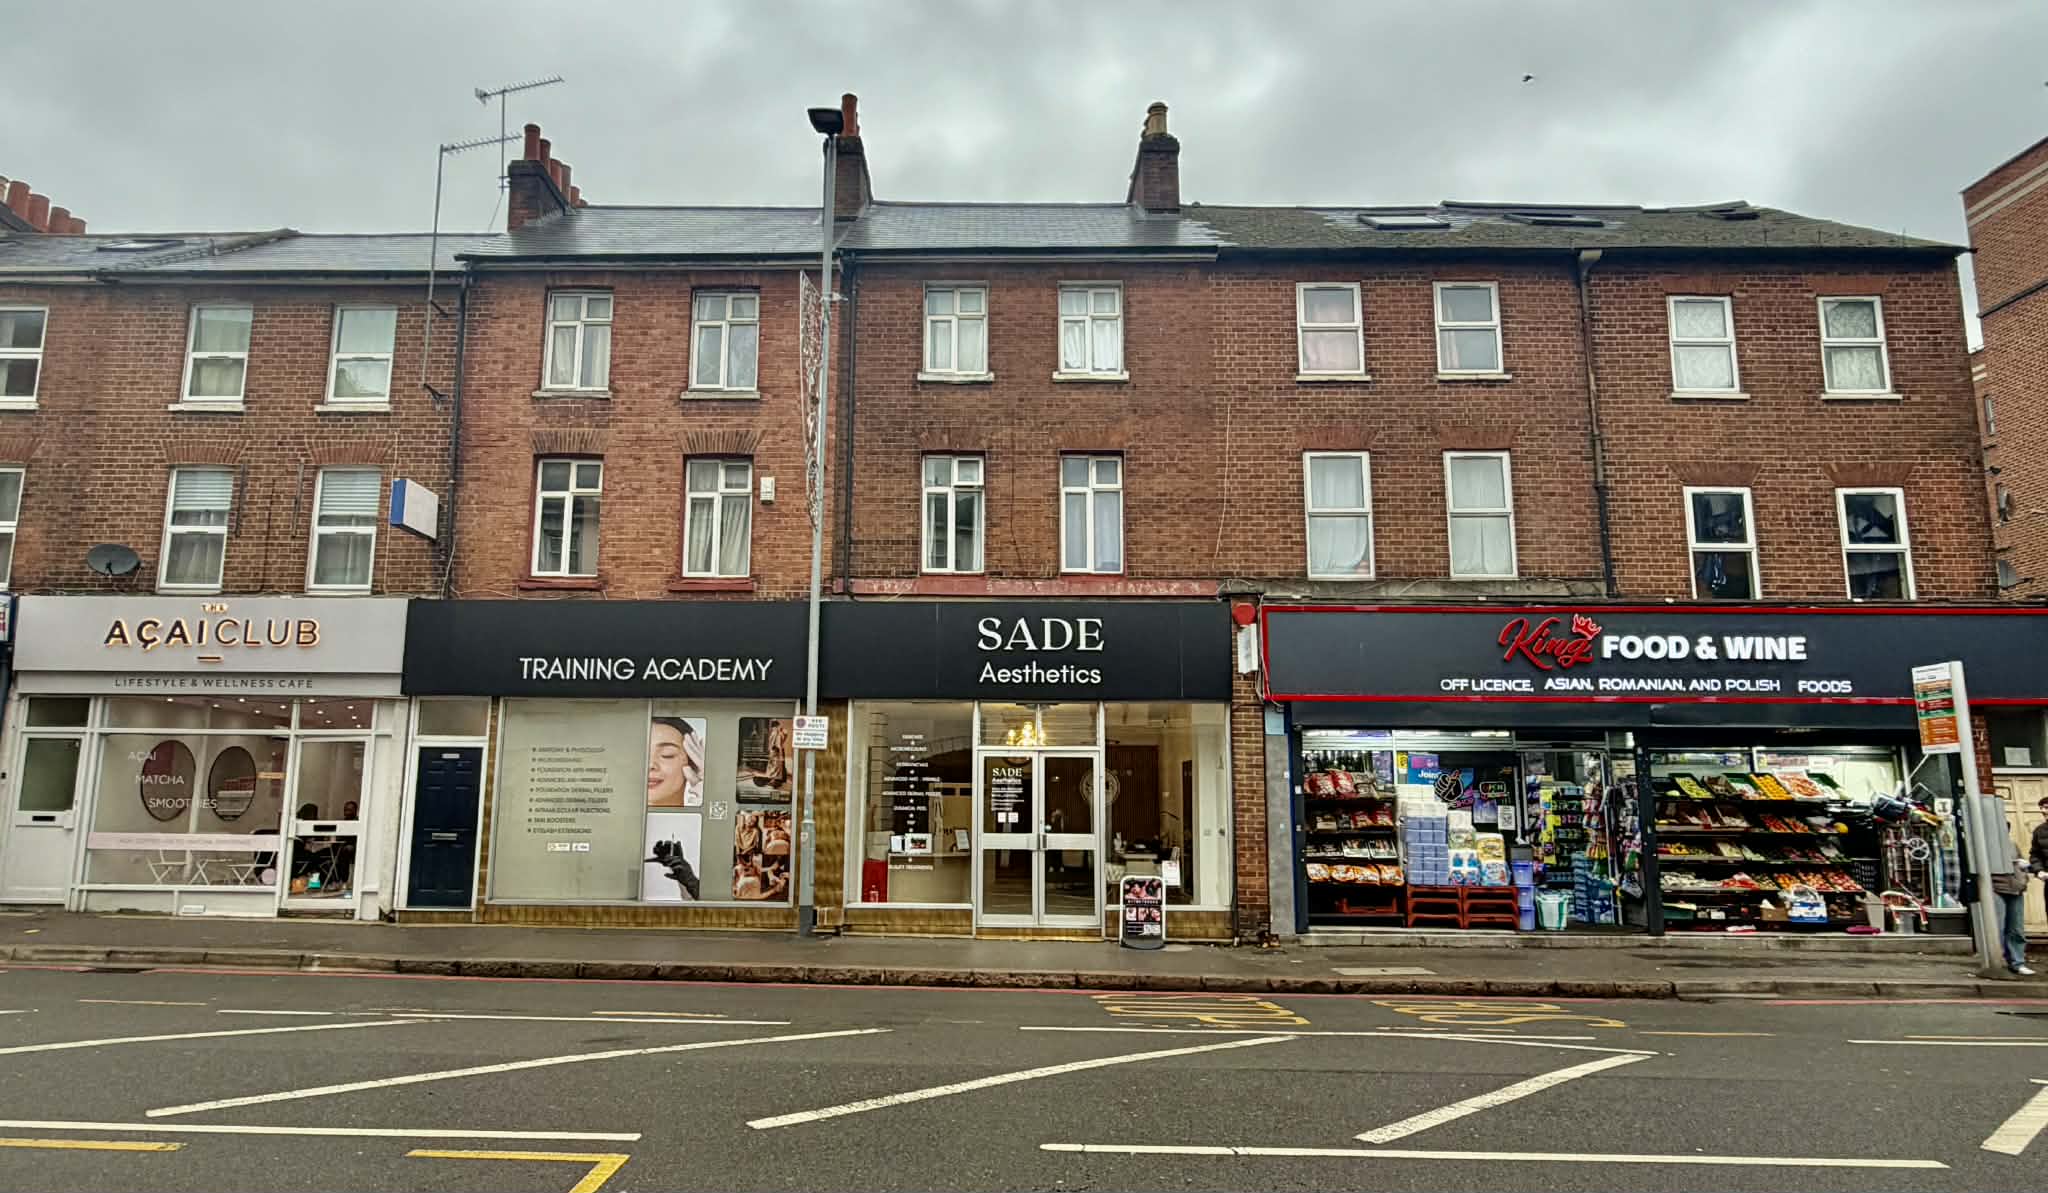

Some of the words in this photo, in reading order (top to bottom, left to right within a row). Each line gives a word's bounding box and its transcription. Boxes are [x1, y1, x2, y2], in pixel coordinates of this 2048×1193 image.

[977, 617, 1105, 651] SADE
[1497, 616, 1595, 671] King
[1602, 635, 1690, 660] FOOD
[1694, 636, 1719, 660] &
[1723, 636, 1808, 661] WINE
[519, 657, 636, 681] TRAINING
[642, 657, 774, 682] ACADEMY
[979, 660, 1102, 684] Aesthetics
[115, 678, 187, 688] LIFESTYLE
[190, 679, 199, 688] &
[202, 678, 275, 689] WELLNESS
[278, 679, 314, 689] CAFE
[1440, 679, 1469, 691] OFF
[1689, 679, 1722, 692] AND
[1725, 679, 1781, 692] POLISH
[1797, 680, 1853, 693] FOODS
[135, 774, 185, 785] MATCHA
[991, 767, 1023, 777] SADE
